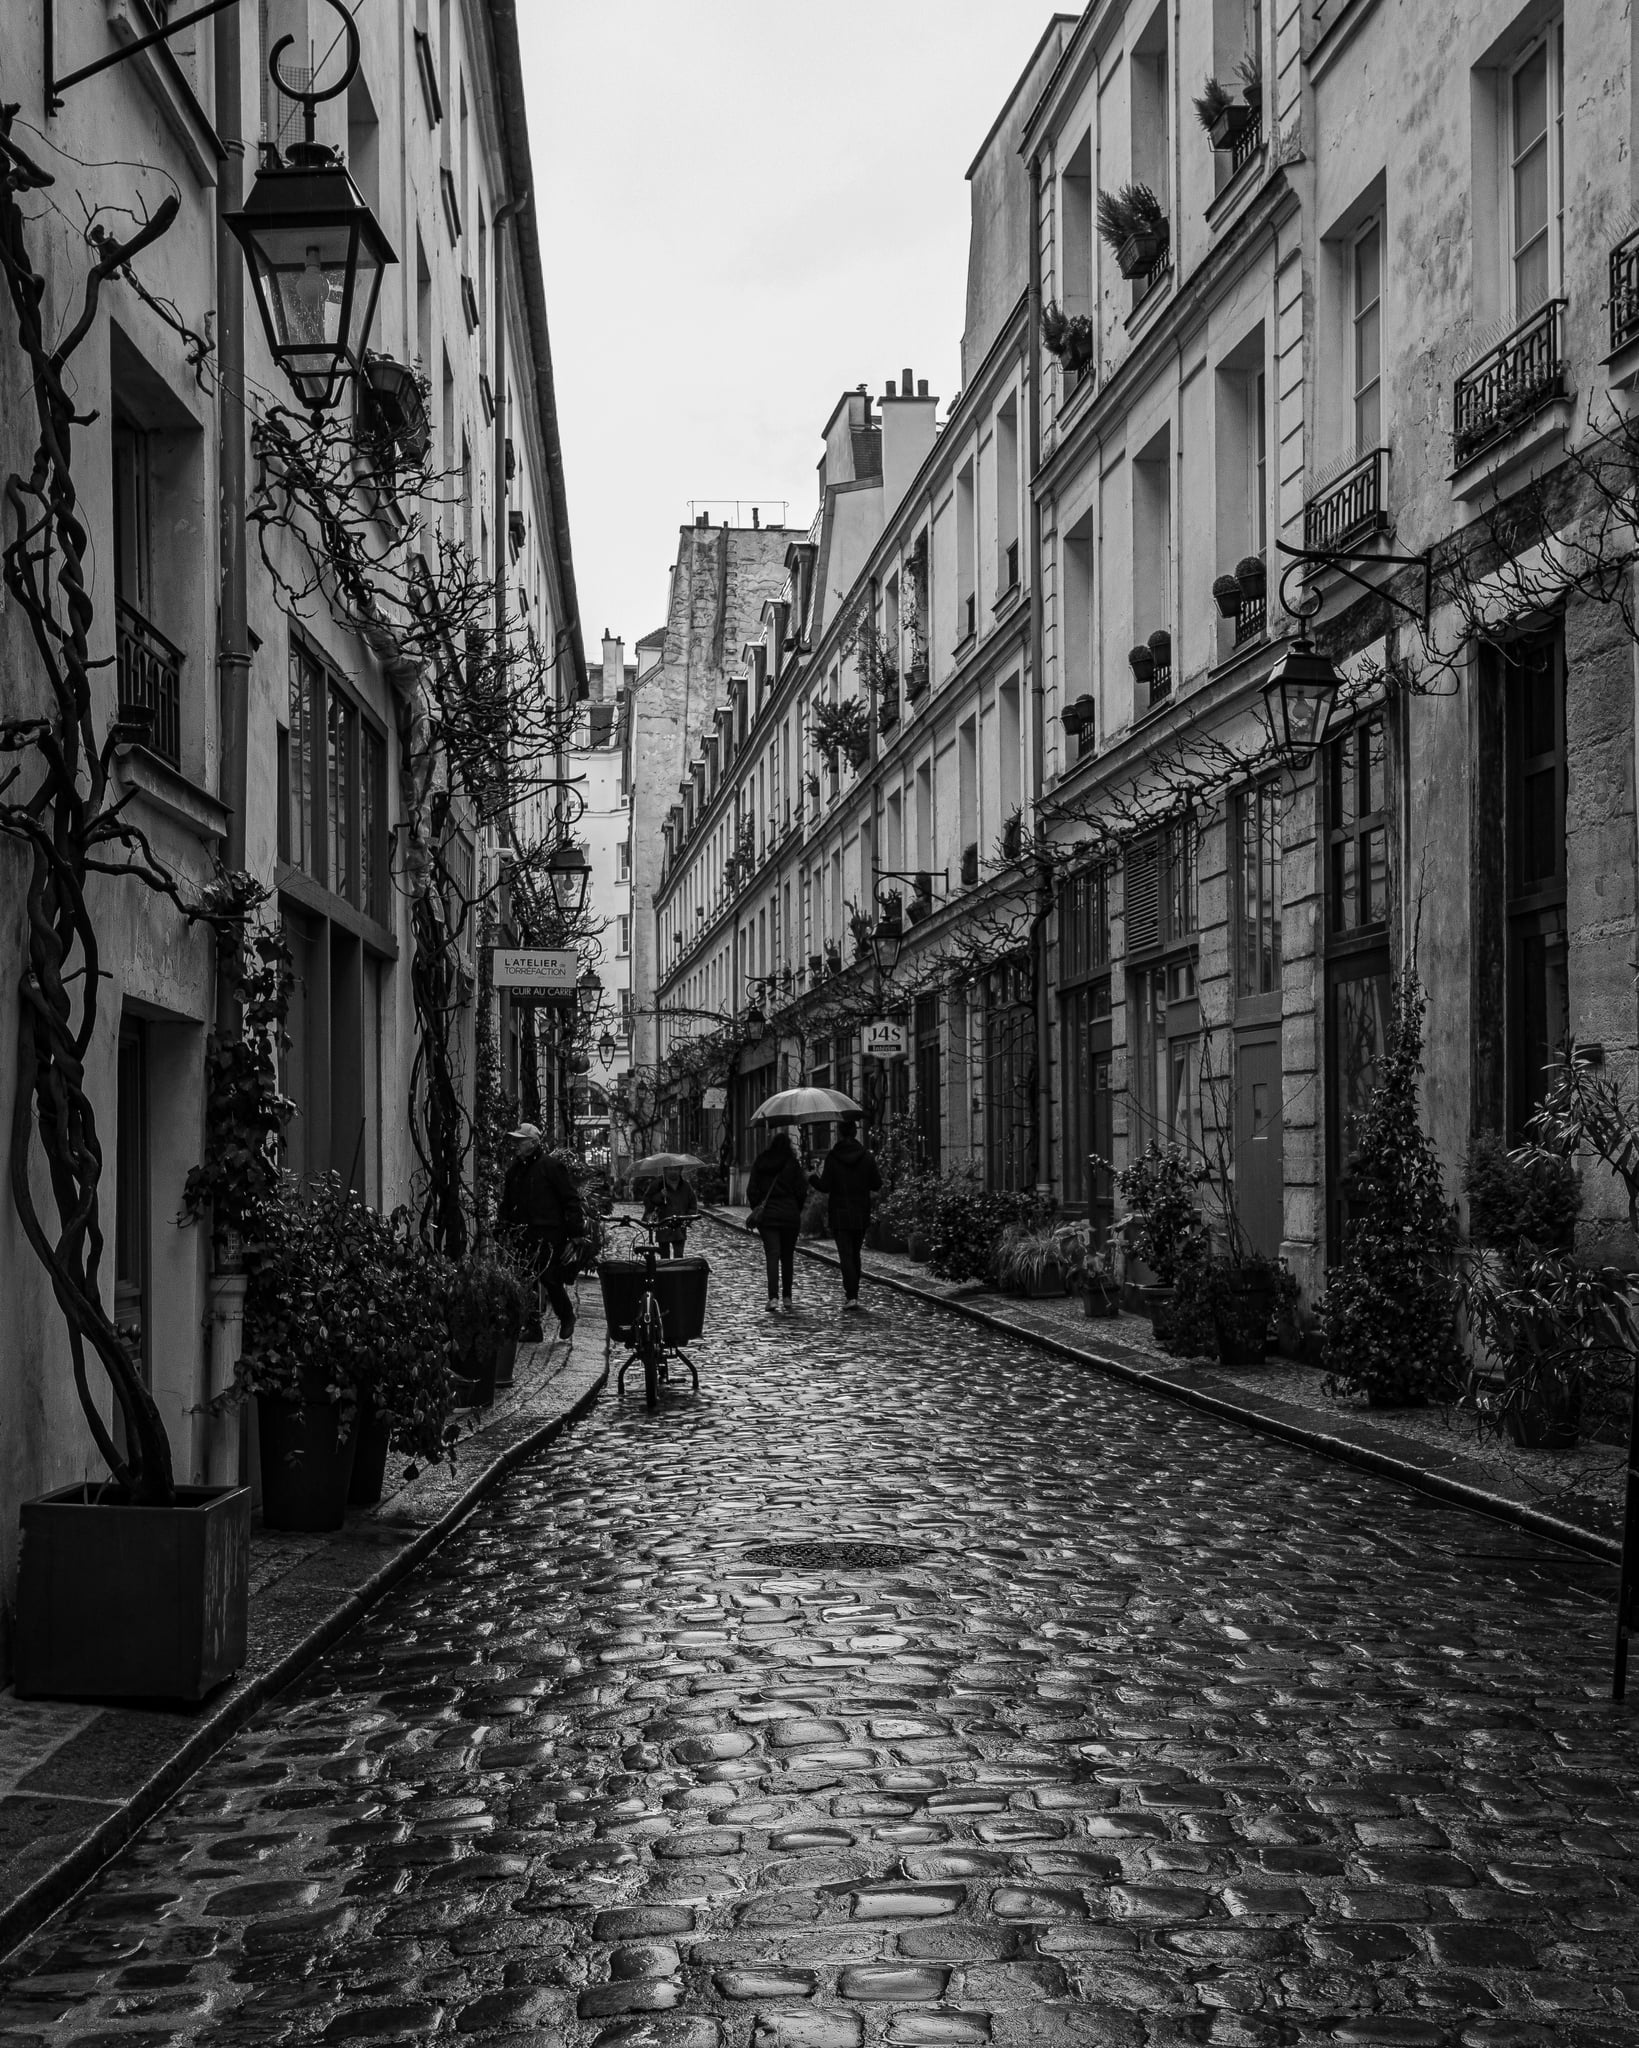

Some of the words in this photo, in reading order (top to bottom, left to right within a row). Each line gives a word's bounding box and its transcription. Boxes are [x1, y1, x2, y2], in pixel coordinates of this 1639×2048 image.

[504, 958, 558, 967] L'ATELIER
[512, 987, 531, 996] CUIR
[533, 987, 545, 996] AU
[868, 1026, 901, 1042] J4S
